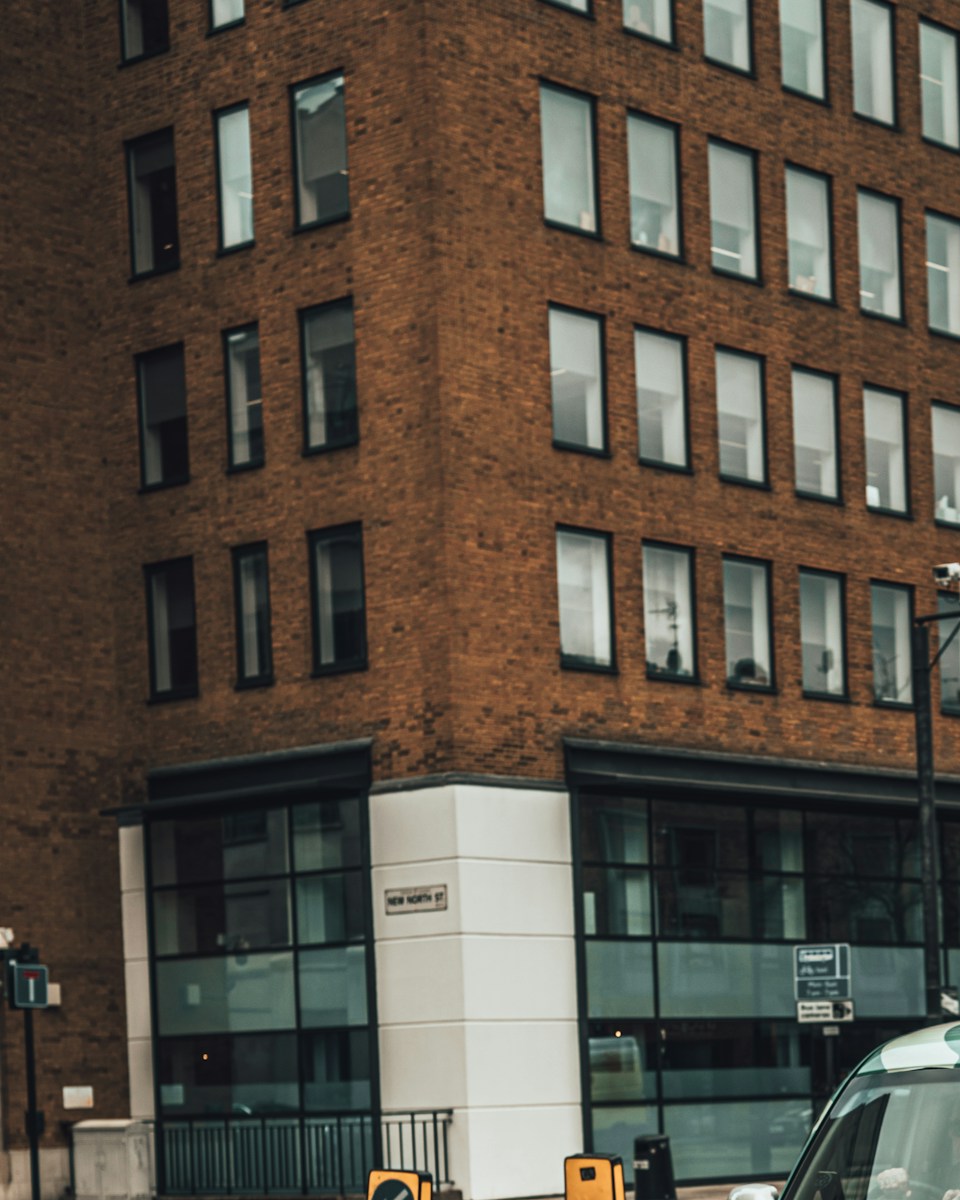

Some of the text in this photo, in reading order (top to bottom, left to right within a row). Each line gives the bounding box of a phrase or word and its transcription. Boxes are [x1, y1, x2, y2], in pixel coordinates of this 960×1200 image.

[387, 891, 444, 906] NEW NORTH ST
